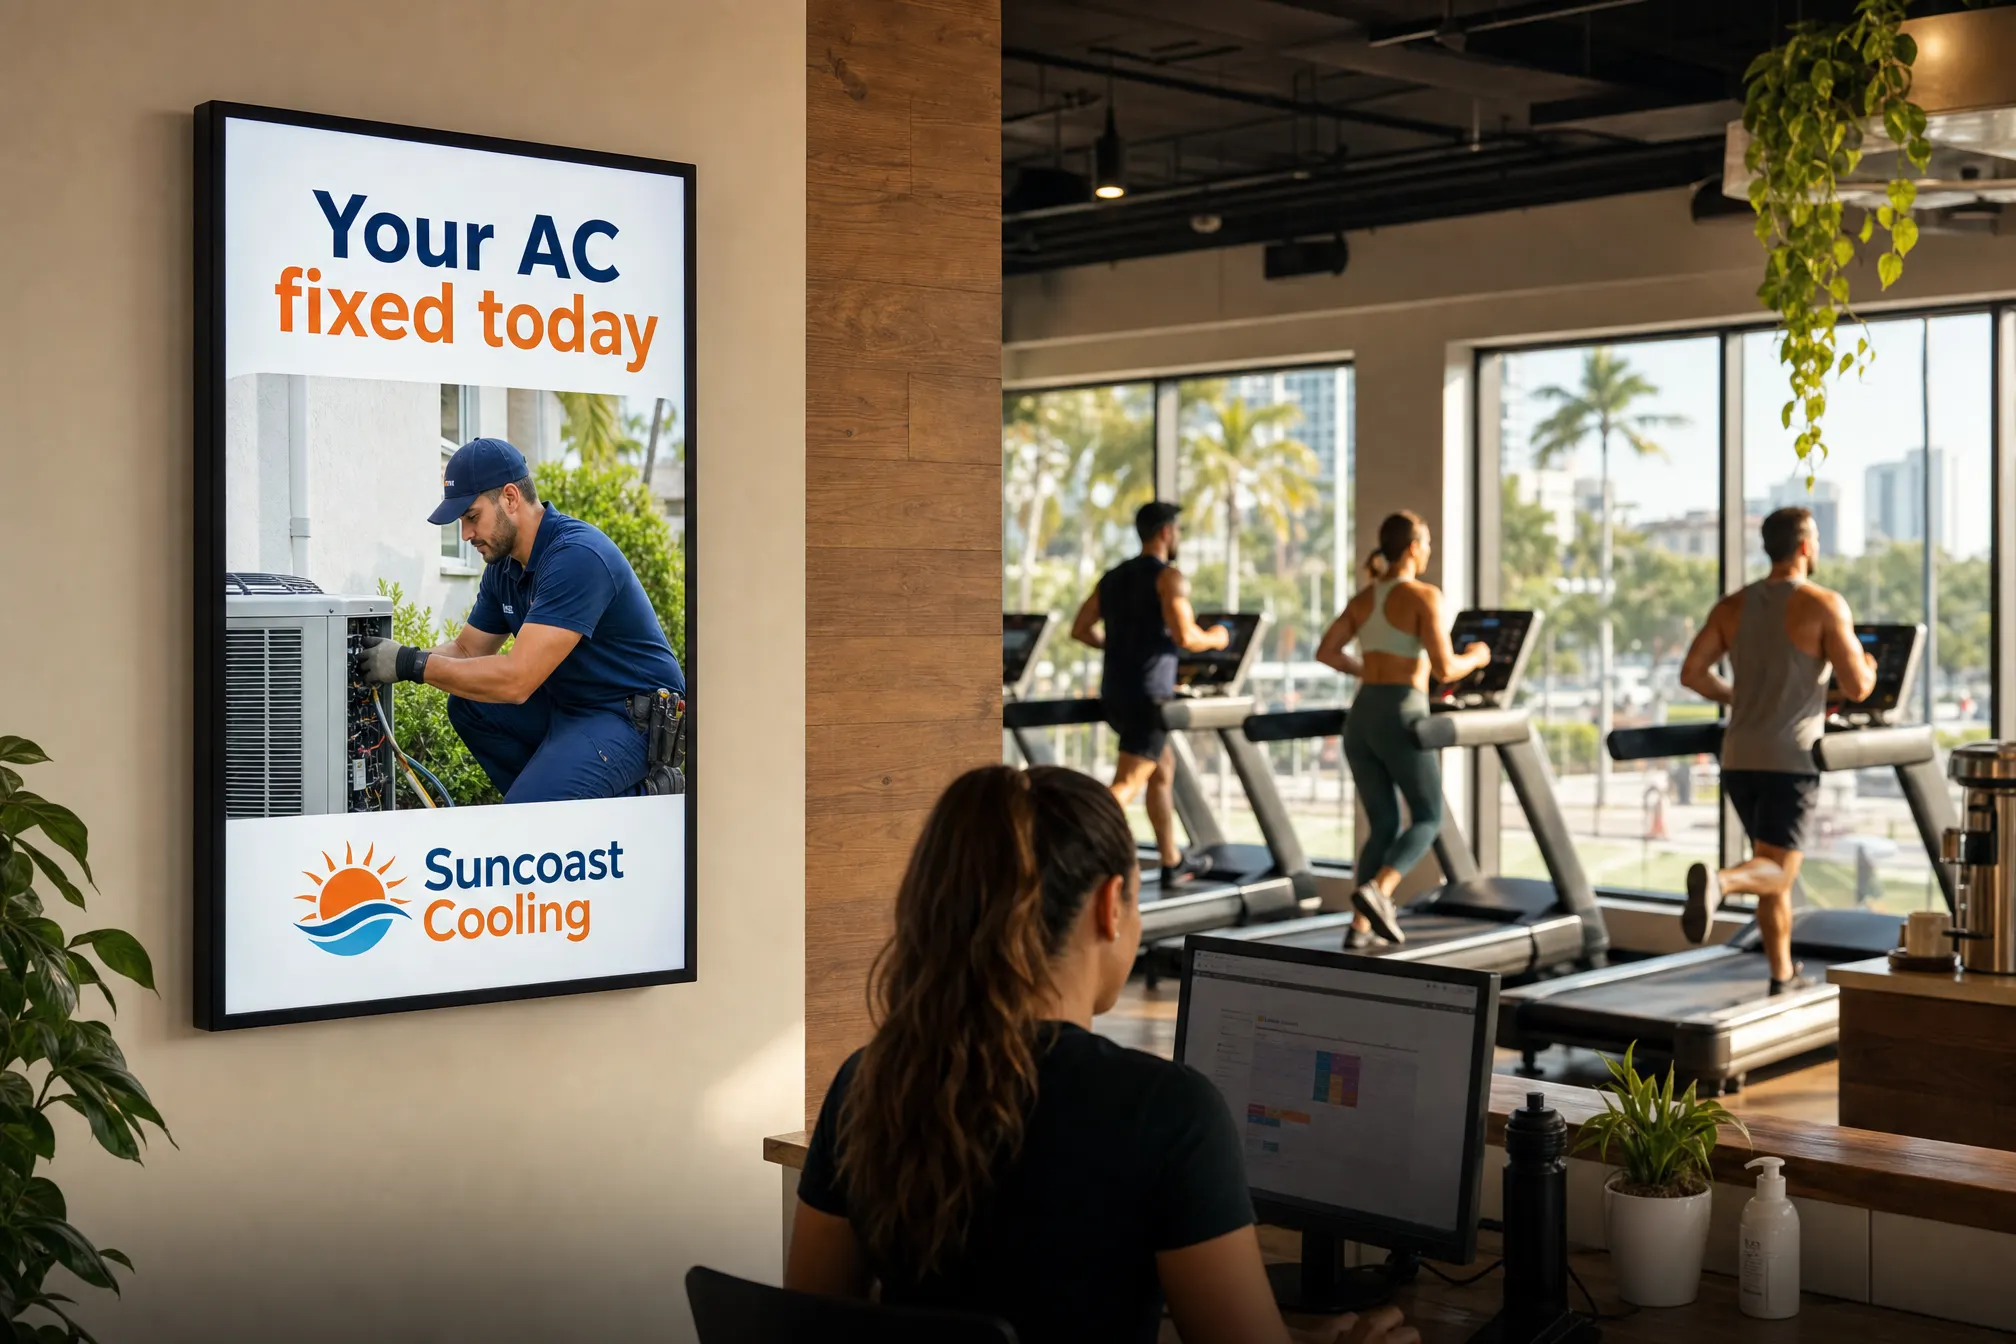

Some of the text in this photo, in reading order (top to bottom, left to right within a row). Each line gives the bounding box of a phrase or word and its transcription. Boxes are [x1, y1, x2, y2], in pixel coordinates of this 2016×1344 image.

[311, 189, 621, 284] Your AC
[274, 265, 659, 374] fixed today
[424, 840, 625, 892] Suncoast
[423, 891, 591, 943] Cooling
